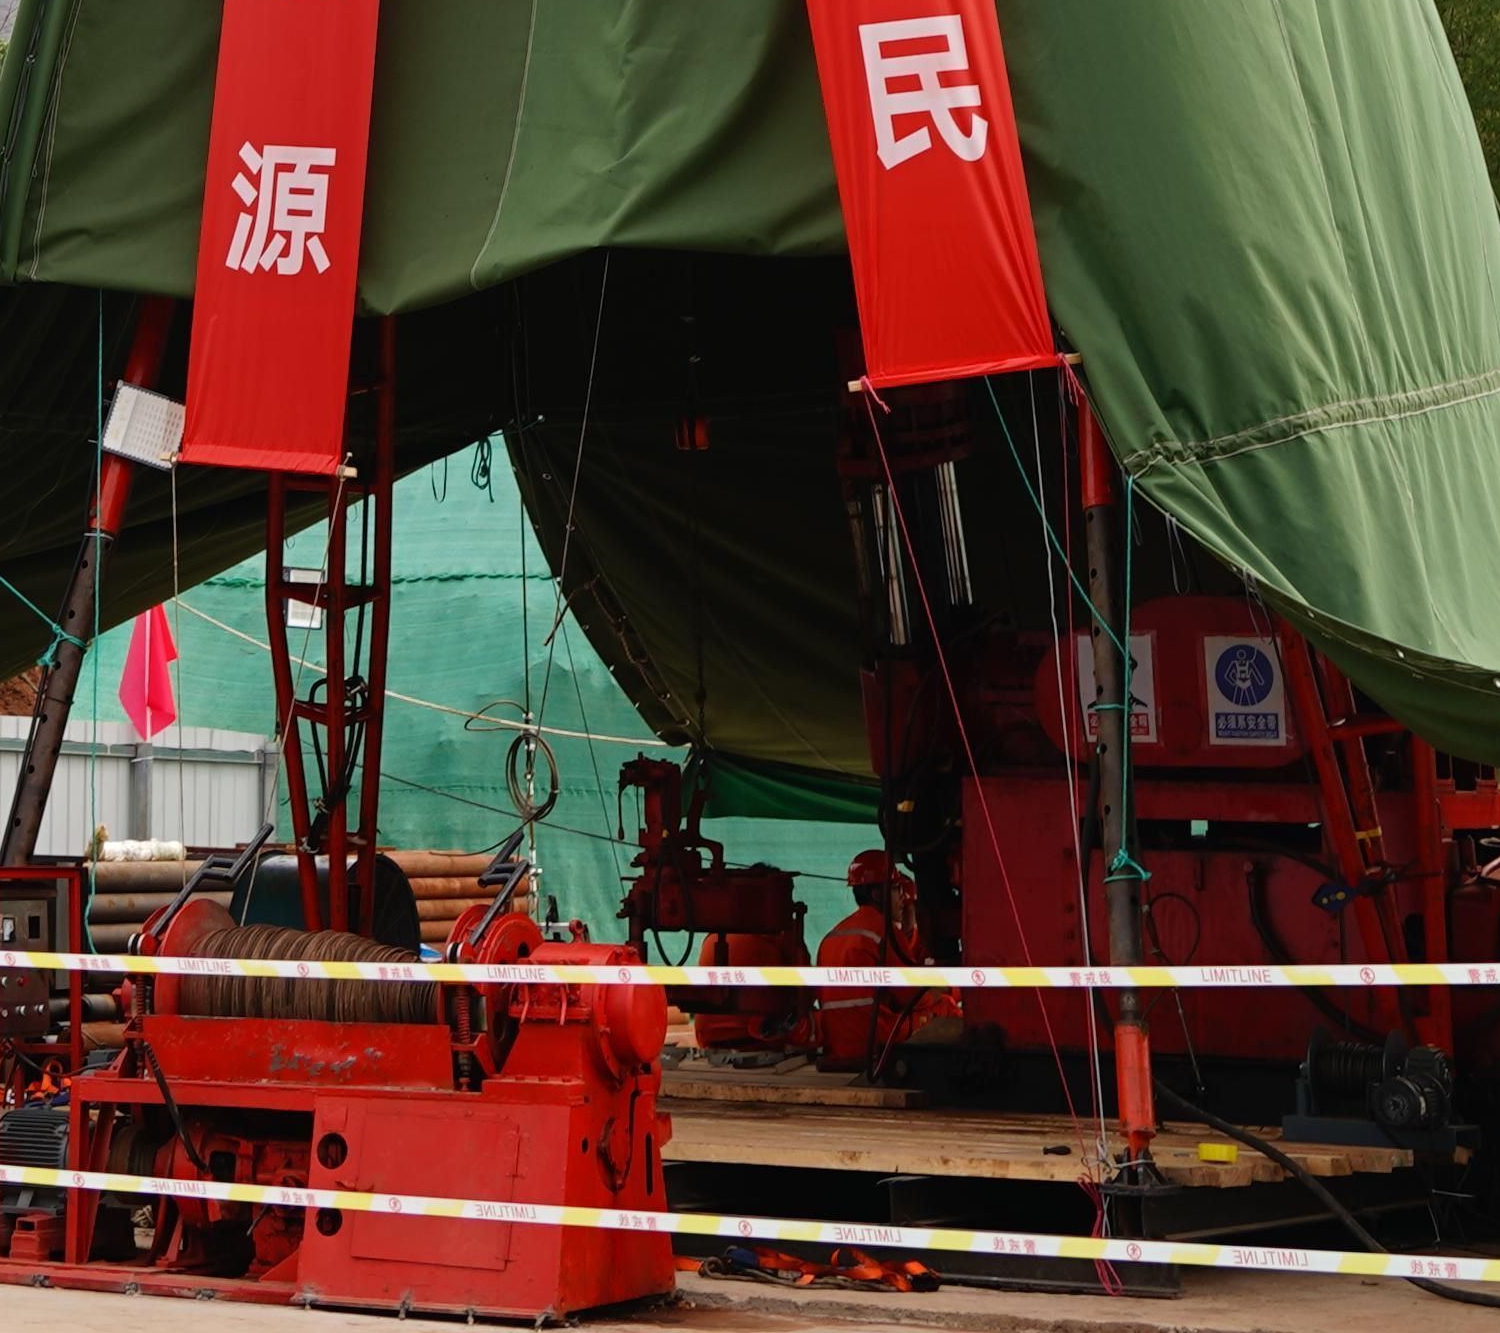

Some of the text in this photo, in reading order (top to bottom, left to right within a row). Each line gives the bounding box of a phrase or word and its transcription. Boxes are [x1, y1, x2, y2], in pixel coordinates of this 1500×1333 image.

[177, 959, 232, 973] LIMITLINE
[487, 966, 546, 980] LIMITLINE
[827, 969, 893, 983] LIMITLINE
[1201, 967, 1272, 983] LIMITLINE
